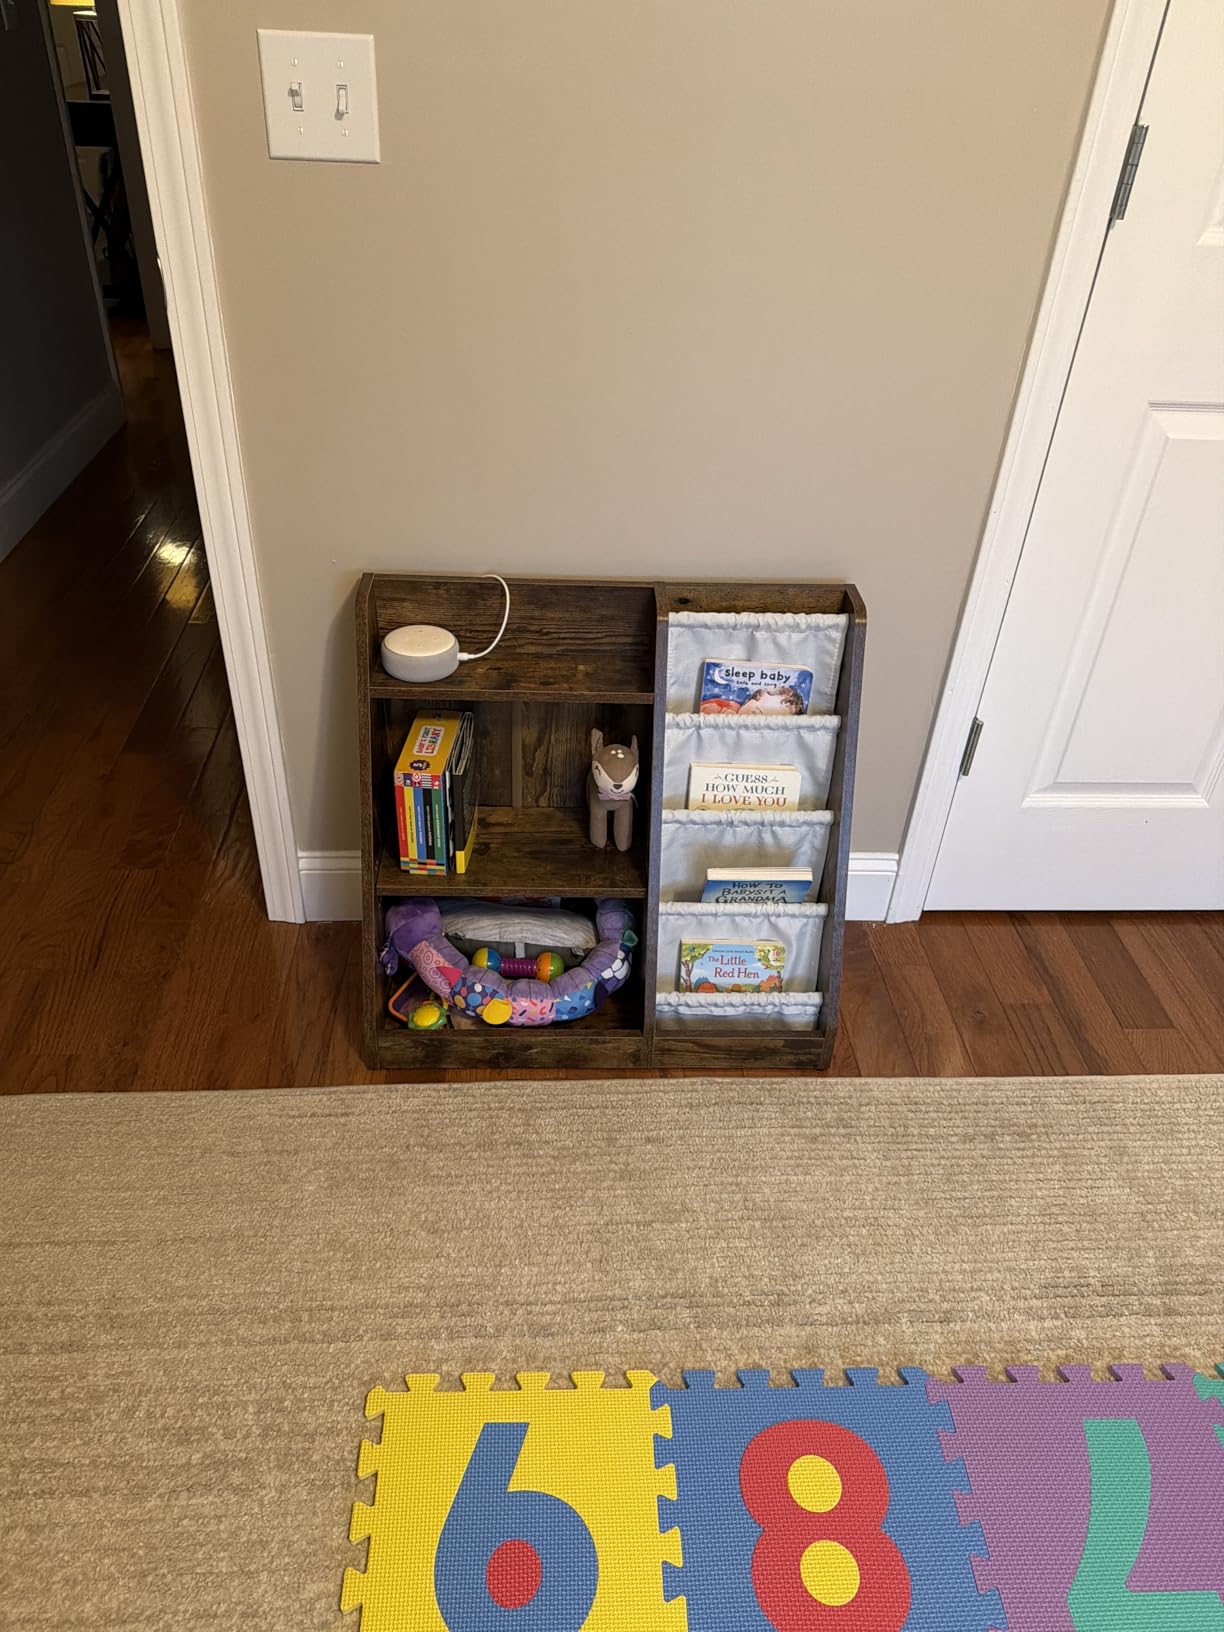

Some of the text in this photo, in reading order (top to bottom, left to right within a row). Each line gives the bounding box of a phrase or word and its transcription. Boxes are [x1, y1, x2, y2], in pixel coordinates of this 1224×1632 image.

[725, 667, 791, 684] sleep baby
[724, 772, 768, 783] GUESS
[705, 783, 785, 795] HOW MUCH
[701, 793, 787, 807] I LOVE YOU
[715, 895, 787, 903] GRANDMA
[720, 955, 746, 965] Little
[714, 967, 760, 979] Red Hen
[740, 1419, 912, 1632] 8
